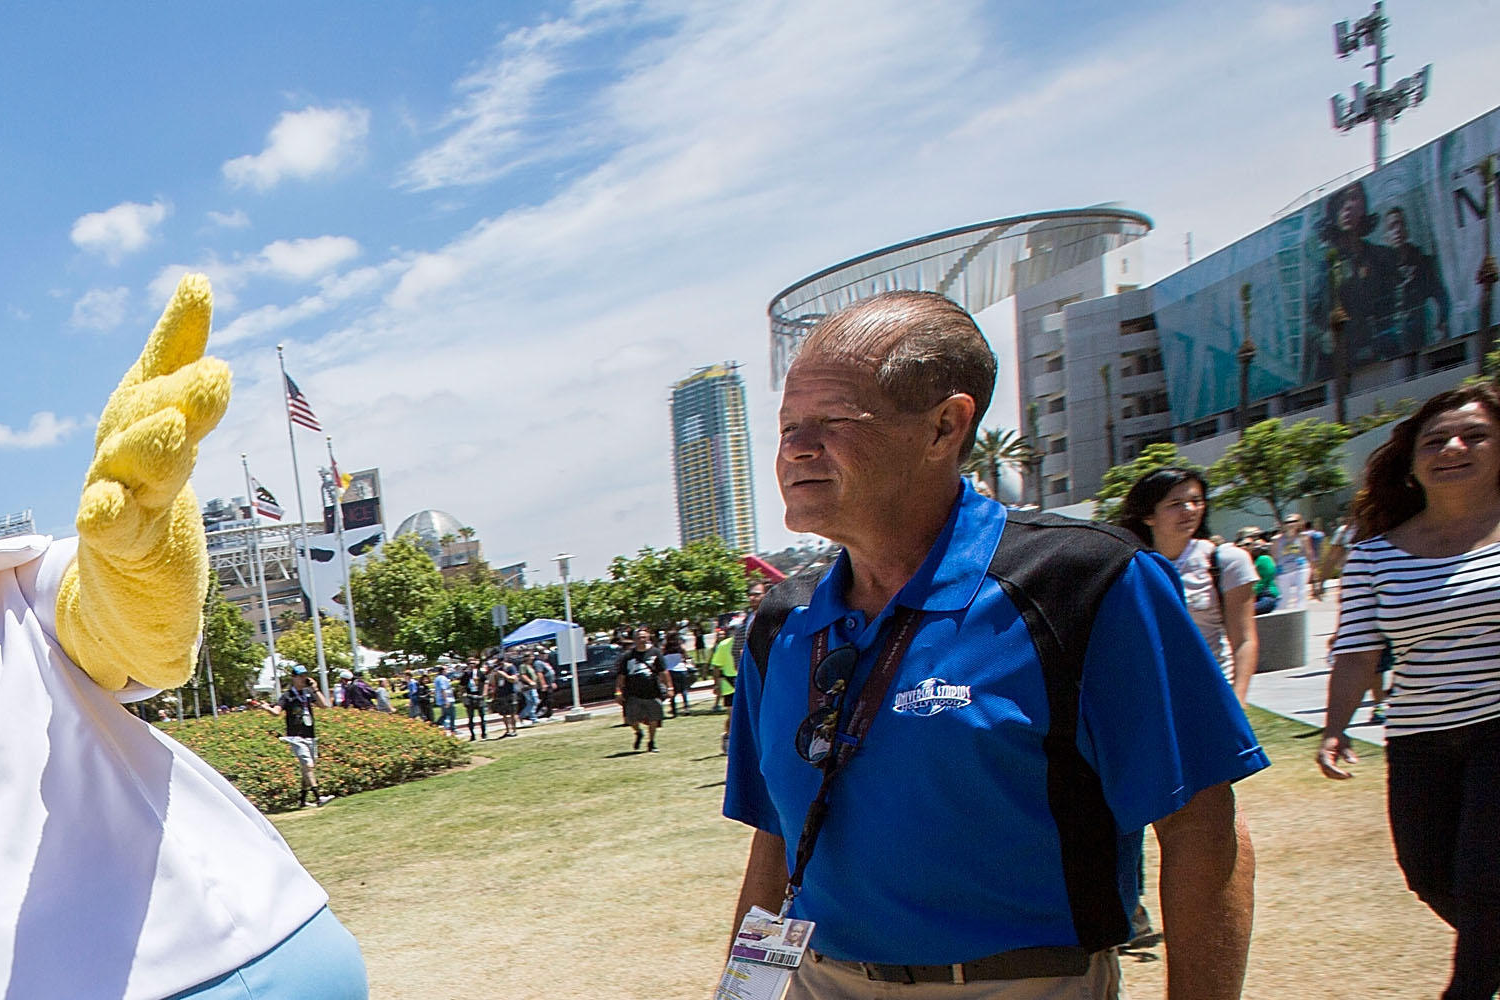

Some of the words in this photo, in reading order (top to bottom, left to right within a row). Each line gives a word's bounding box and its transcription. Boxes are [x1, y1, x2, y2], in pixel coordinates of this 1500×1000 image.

[895, 685, 935, 706] UNIVERSAL
[936, 685, 971, 699] STUDIOS
[901, 699, 962, 711] HOLLYWOOD
